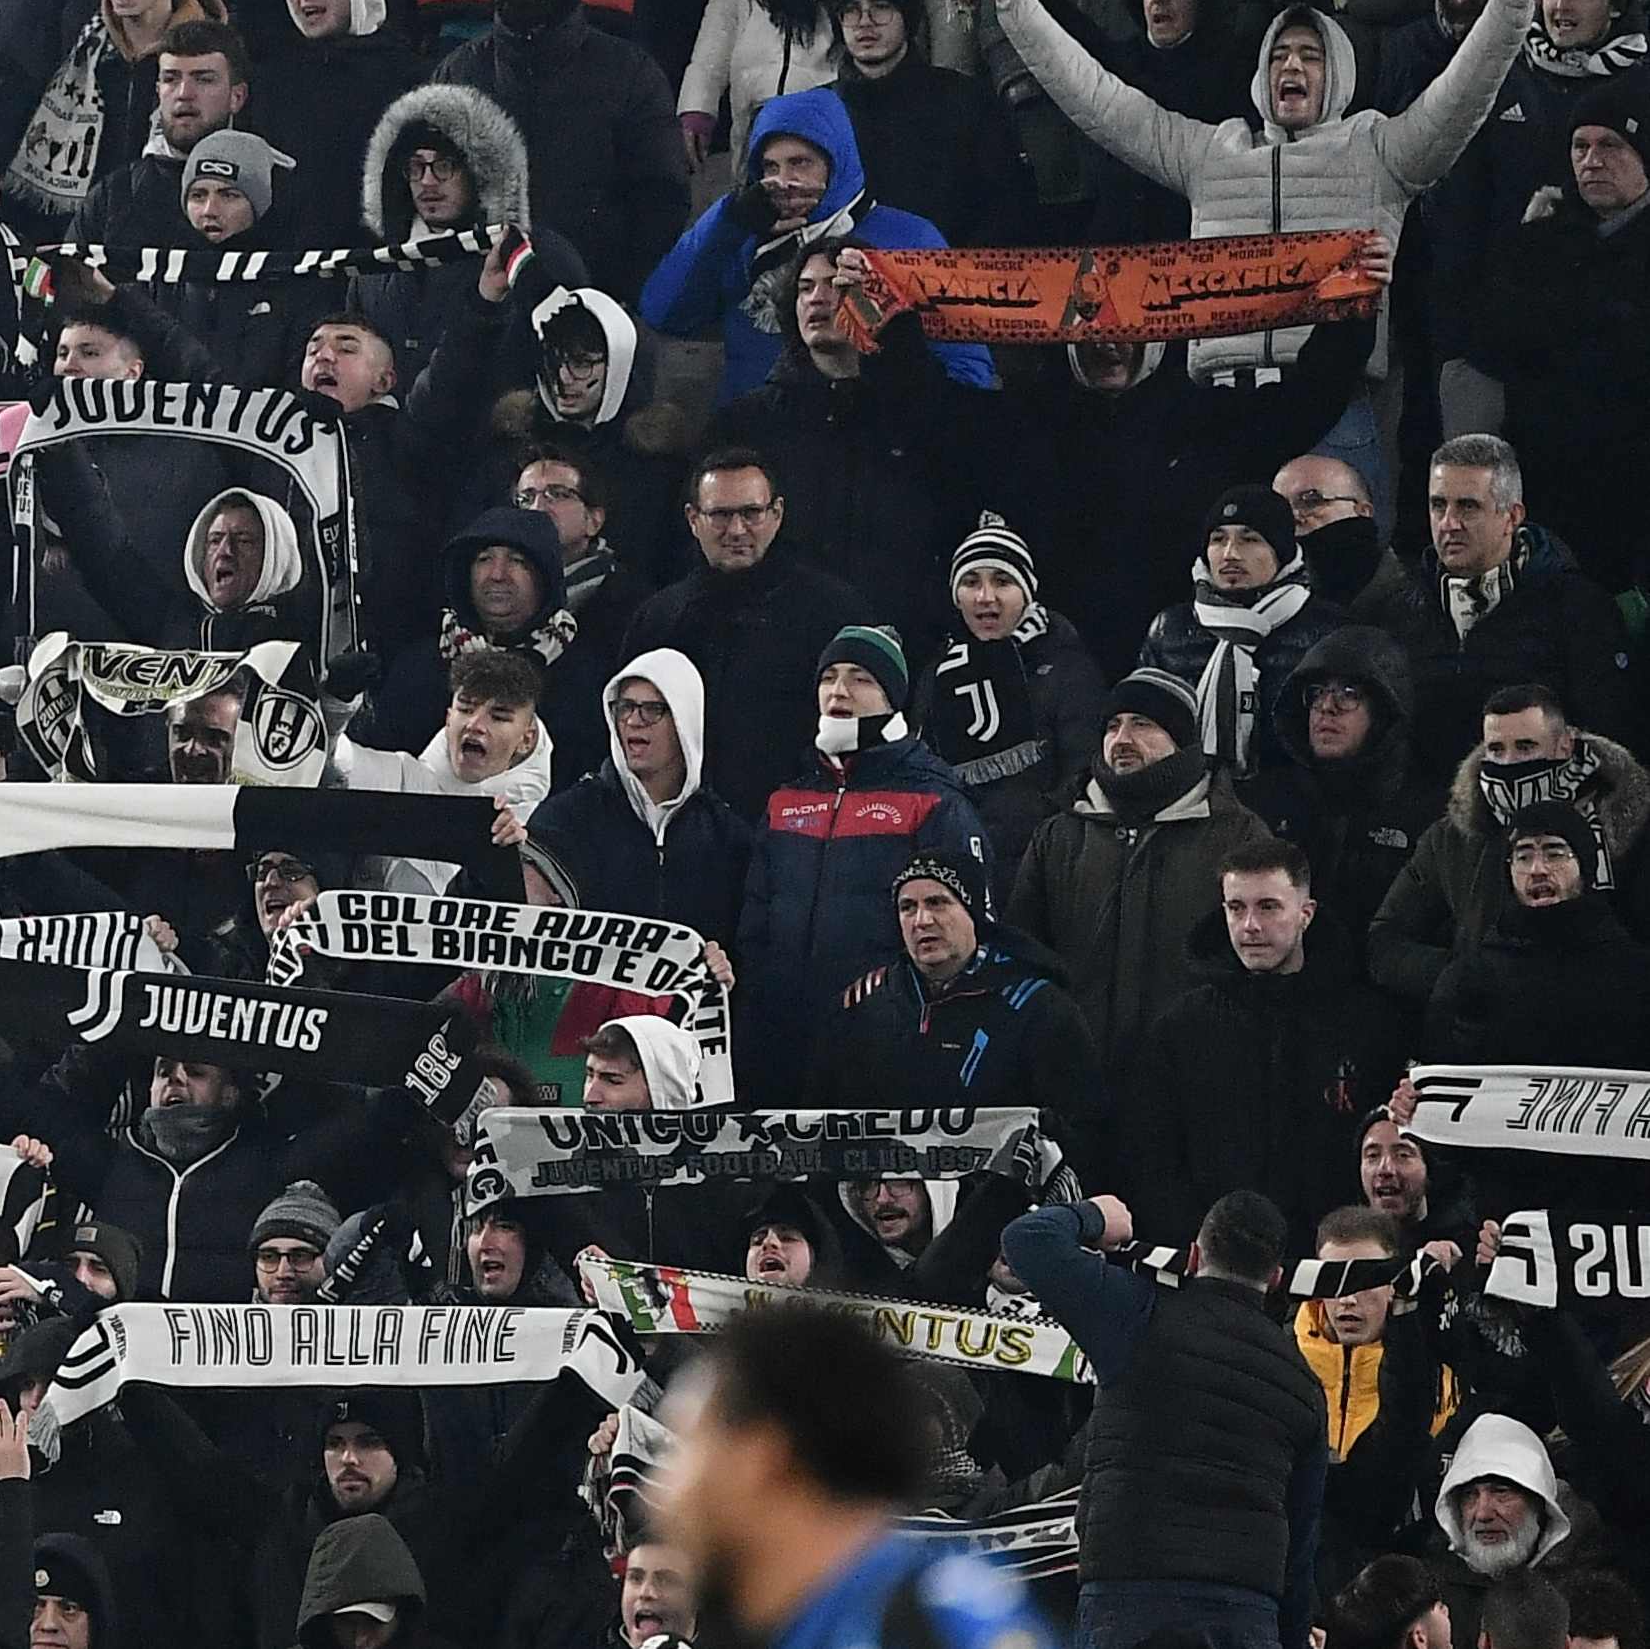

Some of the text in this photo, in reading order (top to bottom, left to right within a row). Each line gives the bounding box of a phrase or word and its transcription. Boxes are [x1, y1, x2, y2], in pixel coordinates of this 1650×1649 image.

[53, 378, 316, 455] JUVENTUS
[337, 893, 521, 933] COLORE
[533, 910, 690, 953] AVRA'
[342, 925, 420, 957] DEL
[431, 929, 603, 975] BIANCO
[612, 951, 644, 984] E
[139, 982, 330, 1053] JUVENTUS
[538, 1109, 722, 1151] UNICO
[532, 1149, 677, 1188] JUVENTUS
[687, 1143, 831, 1180] FOOTBALL
[843, 1143, 915, 1175] CLUB
[163, 1308, 525, 1367] FINO ALLA FINE
